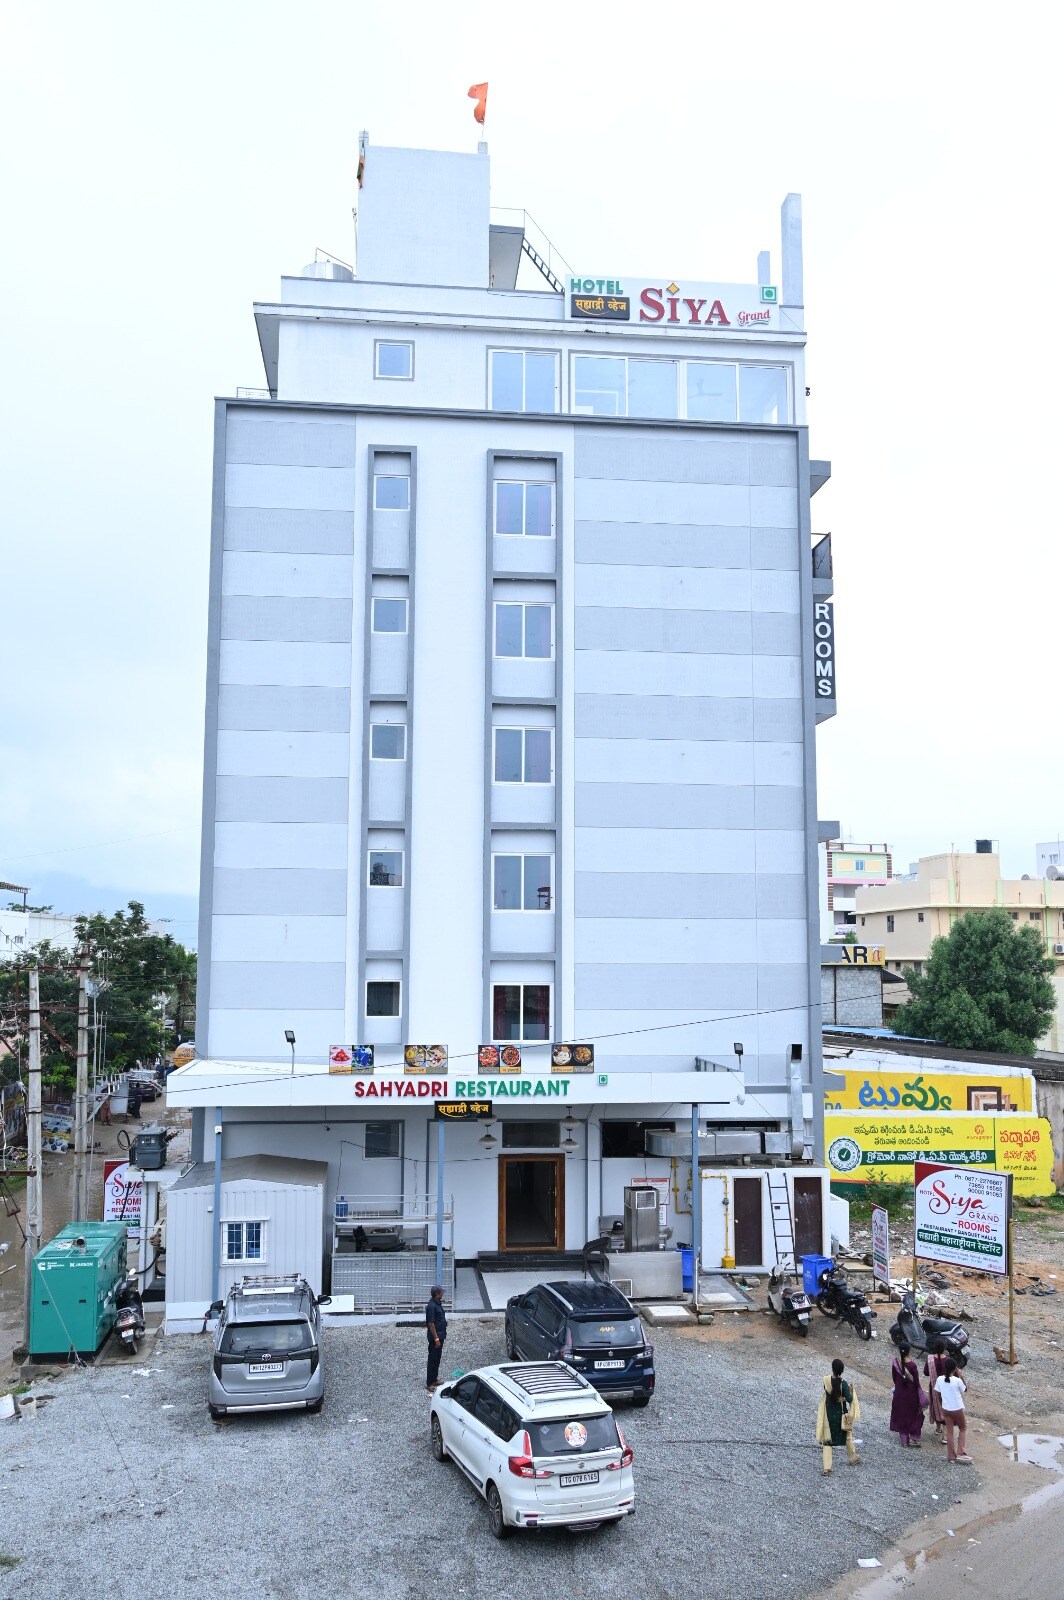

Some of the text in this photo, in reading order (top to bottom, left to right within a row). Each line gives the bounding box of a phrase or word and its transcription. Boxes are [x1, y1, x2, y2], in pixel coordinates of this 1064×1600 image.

[571, 278, 624, 294] HOTEL
[639, 287, 730, 325] SIYA
[738, 309, 771, 325] Grand
[815, 603, 833, 696] ROOMS
[354, 1079, 571, 1097] SAHYADRI RESTAURANT
[438, 1102, 489, 1114] सह्याद्री व्हेज
[1000, 1129, 1040, 1148] పద్మావతి
[919, 1189, 935, 1197] HOTEL
[929, 1180, 988, 1215] Siya
[968, 1212, 1000, 1223] GRAND
[923, 1223, 953, 1233] RESTAURANT
[958, 1220, 991, 1233] ROOMS
